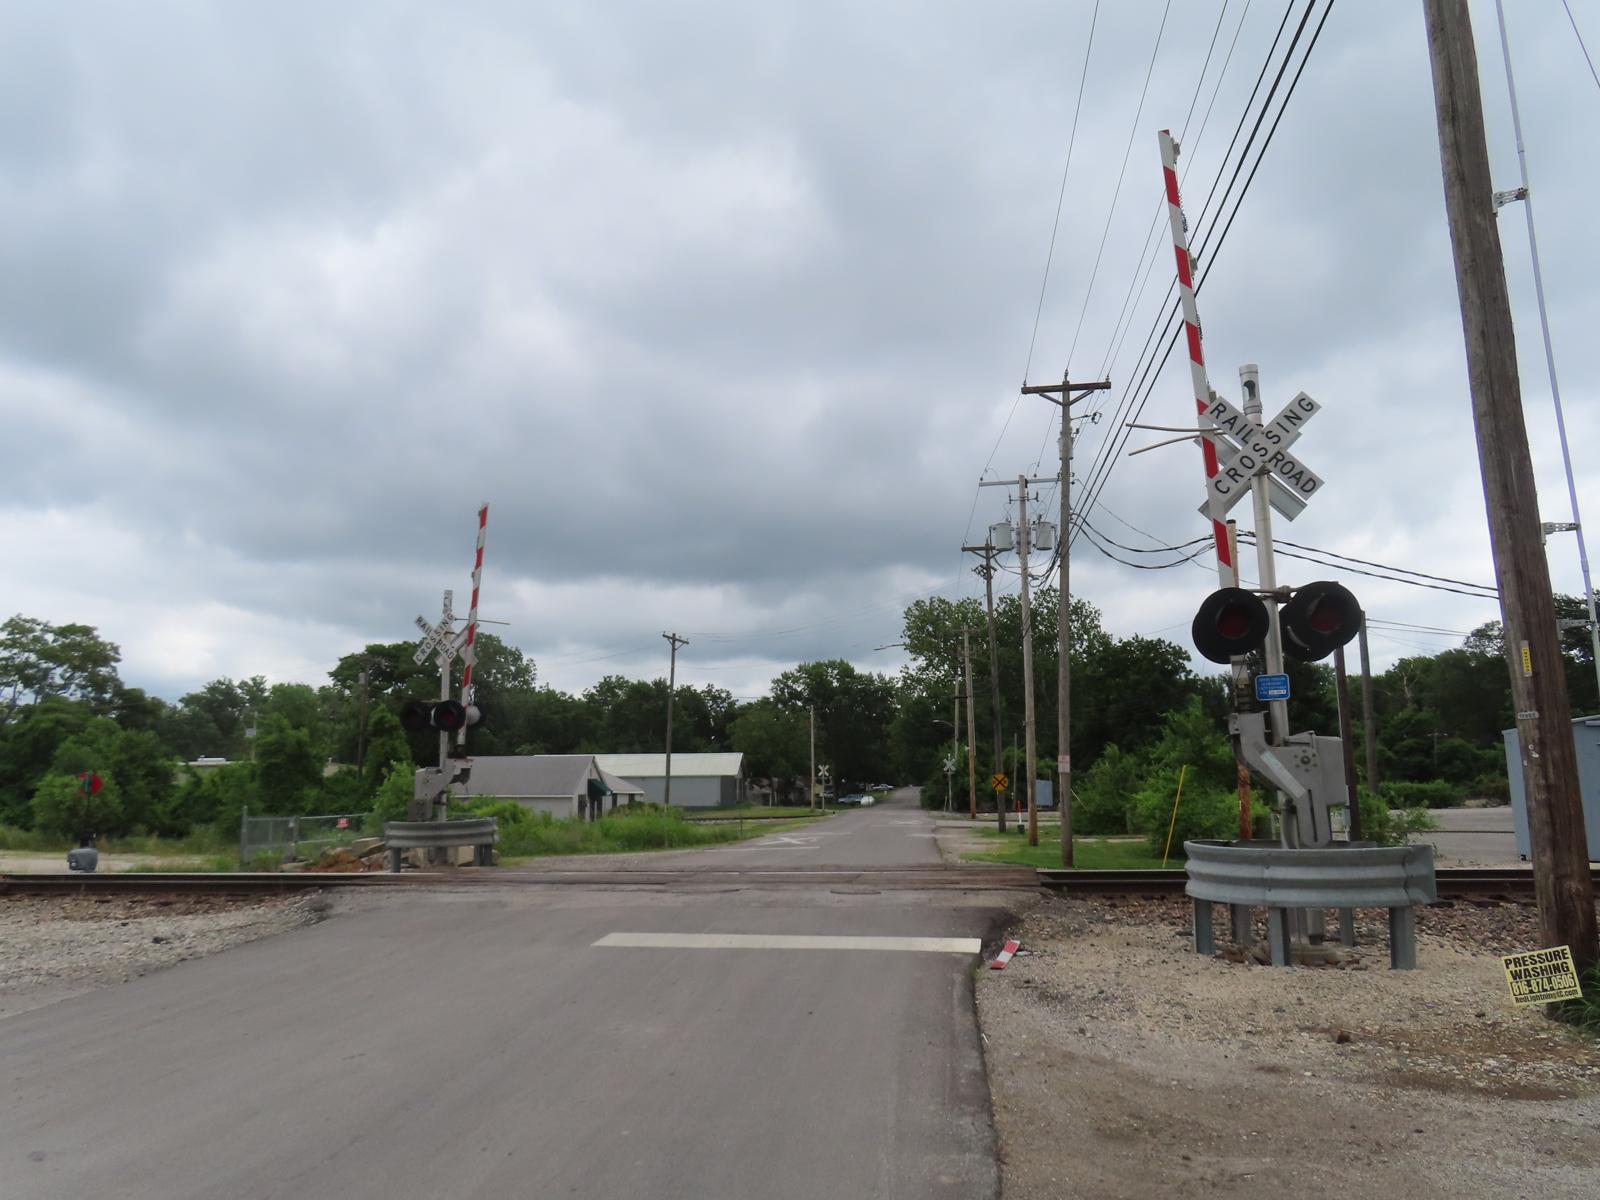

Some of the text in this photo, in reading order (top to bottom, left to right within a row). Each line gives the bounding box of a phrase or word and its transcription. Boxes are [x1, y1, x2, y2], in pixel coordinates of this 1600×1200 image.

[1210, 402, 1316, 493] RAIL ROAD
[1214, 397, 1314, 495] CROSSING
[415, 613, 454, 662] CROSSING
[416, 616, 454, 660] RAIL ROAD
[1504, 949, 1569, 969] PRESSURE
[1509, 961, 1570, 981] WASHING
[1511, 974, 1575, 996] 816-874-0506
